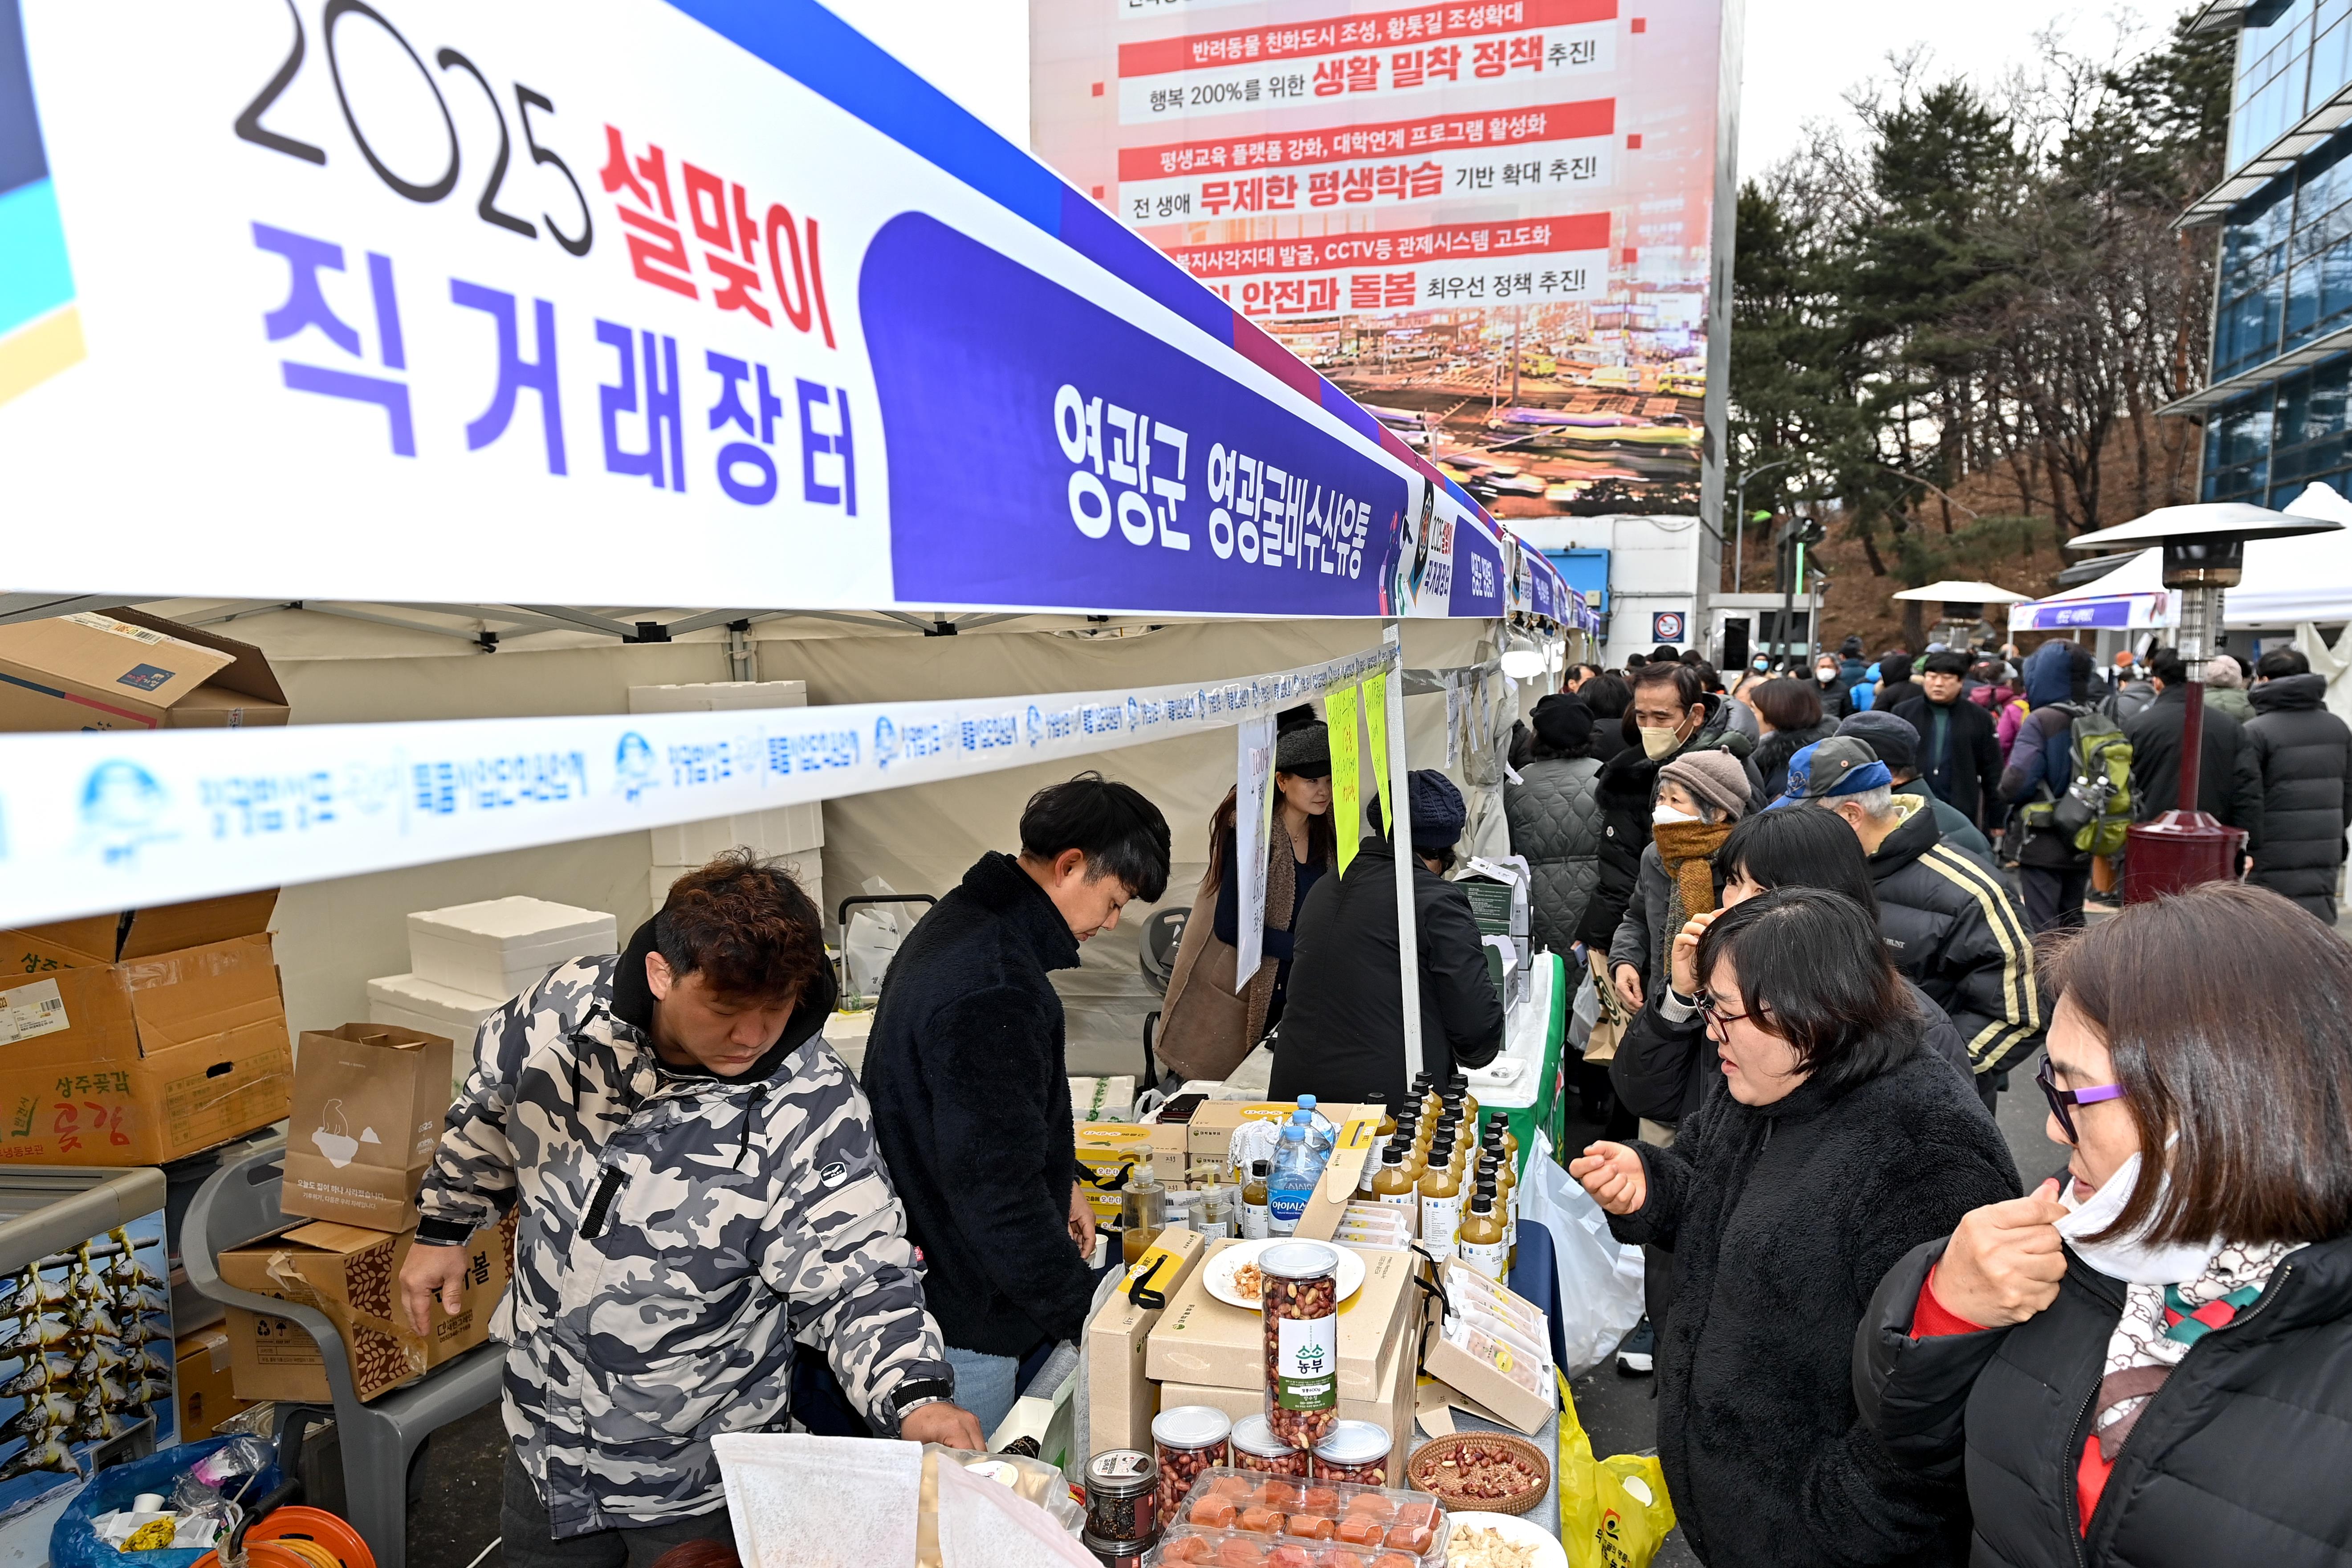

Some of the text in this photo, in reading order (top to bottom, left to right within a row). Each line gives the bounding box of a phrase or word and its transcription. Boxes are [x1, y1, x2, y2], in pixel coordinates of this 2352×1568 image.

[1193, 2, 1523, 63] 반려동물 친화도시 조성, 황톳길 조성확대
[1150, 34, 1595, 112] 행복 200%를 위한 생활 밀착 정책 추진!
[1161, 112, 1547, 173] 평생교육 플랫폼 강화, 대학연계 프로그램 활성화
[234, 0, 836, 350] 2025 설맞이
[1134, 156, 1596, 219] 전 생애 무제한 평생학습 기반 확대 추진!
[1279, 245, 1319, 265] 발굴,
[1325, 236, 1393, 261] CCTV등
[1397, 229, 1489, 257] 관제시스템
[1494, 225, 1552, 248] 고도화
[1242, 277, 1340, 316] 안전과
[1350, 271, 1416, 309] 돌봄
[1428, 275, 1484, 299] 최우선
[1493, 272, 1531, 297] 정책
[1539, 269, 1586, 294] 추진!
[251, 220, 856, 517] 직거래장터
[1054, 384, 1371, 580] 영광군 영광굴비수산유통
[1424, 560, 1450, 597] 직거래장터
[56, 1071, 130, 1098] 상주곶감
[297, 1180, 387, 1201] 오늘도 집이 하나 사라졌습니다.
[830, 1169, 842, 1178] PLAY
[1298, 1359, 1323, 1374] 농부
